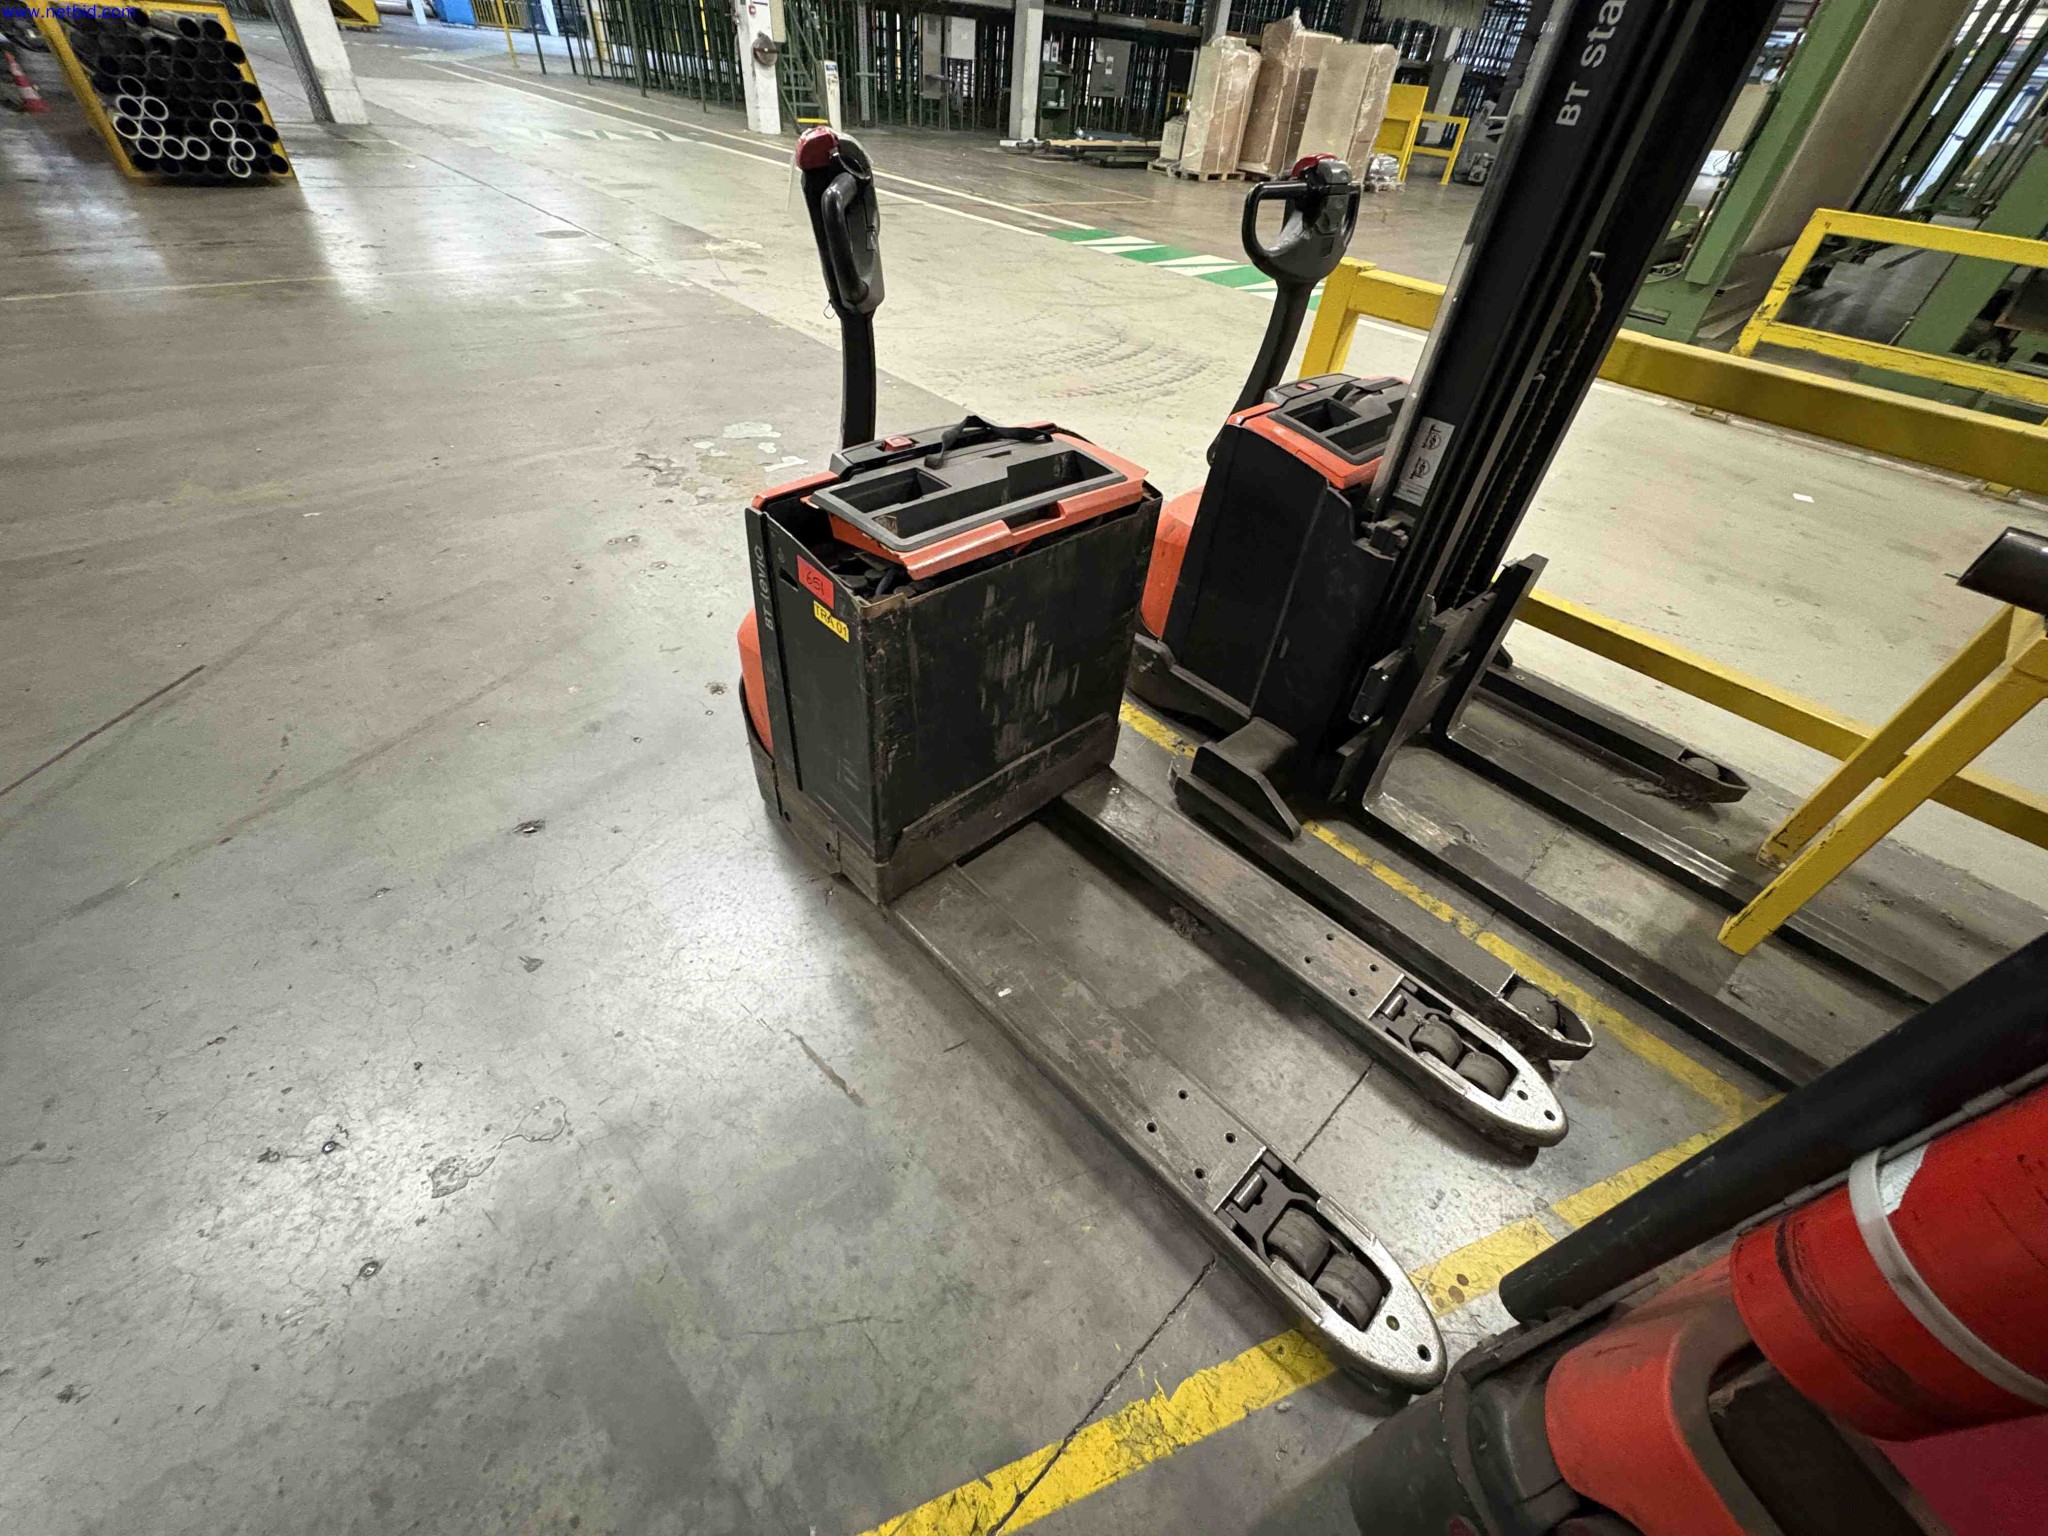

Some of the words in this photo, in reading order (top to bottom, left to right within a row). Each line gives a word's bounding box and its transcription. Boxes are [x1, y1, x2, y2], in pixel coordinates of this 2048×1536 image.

[1555, 81, 1590, 126] BT
[763, 605, 775, 631] BT
[815, 605, 835, 628] TRA
[835, 622, 848, 638] 01
